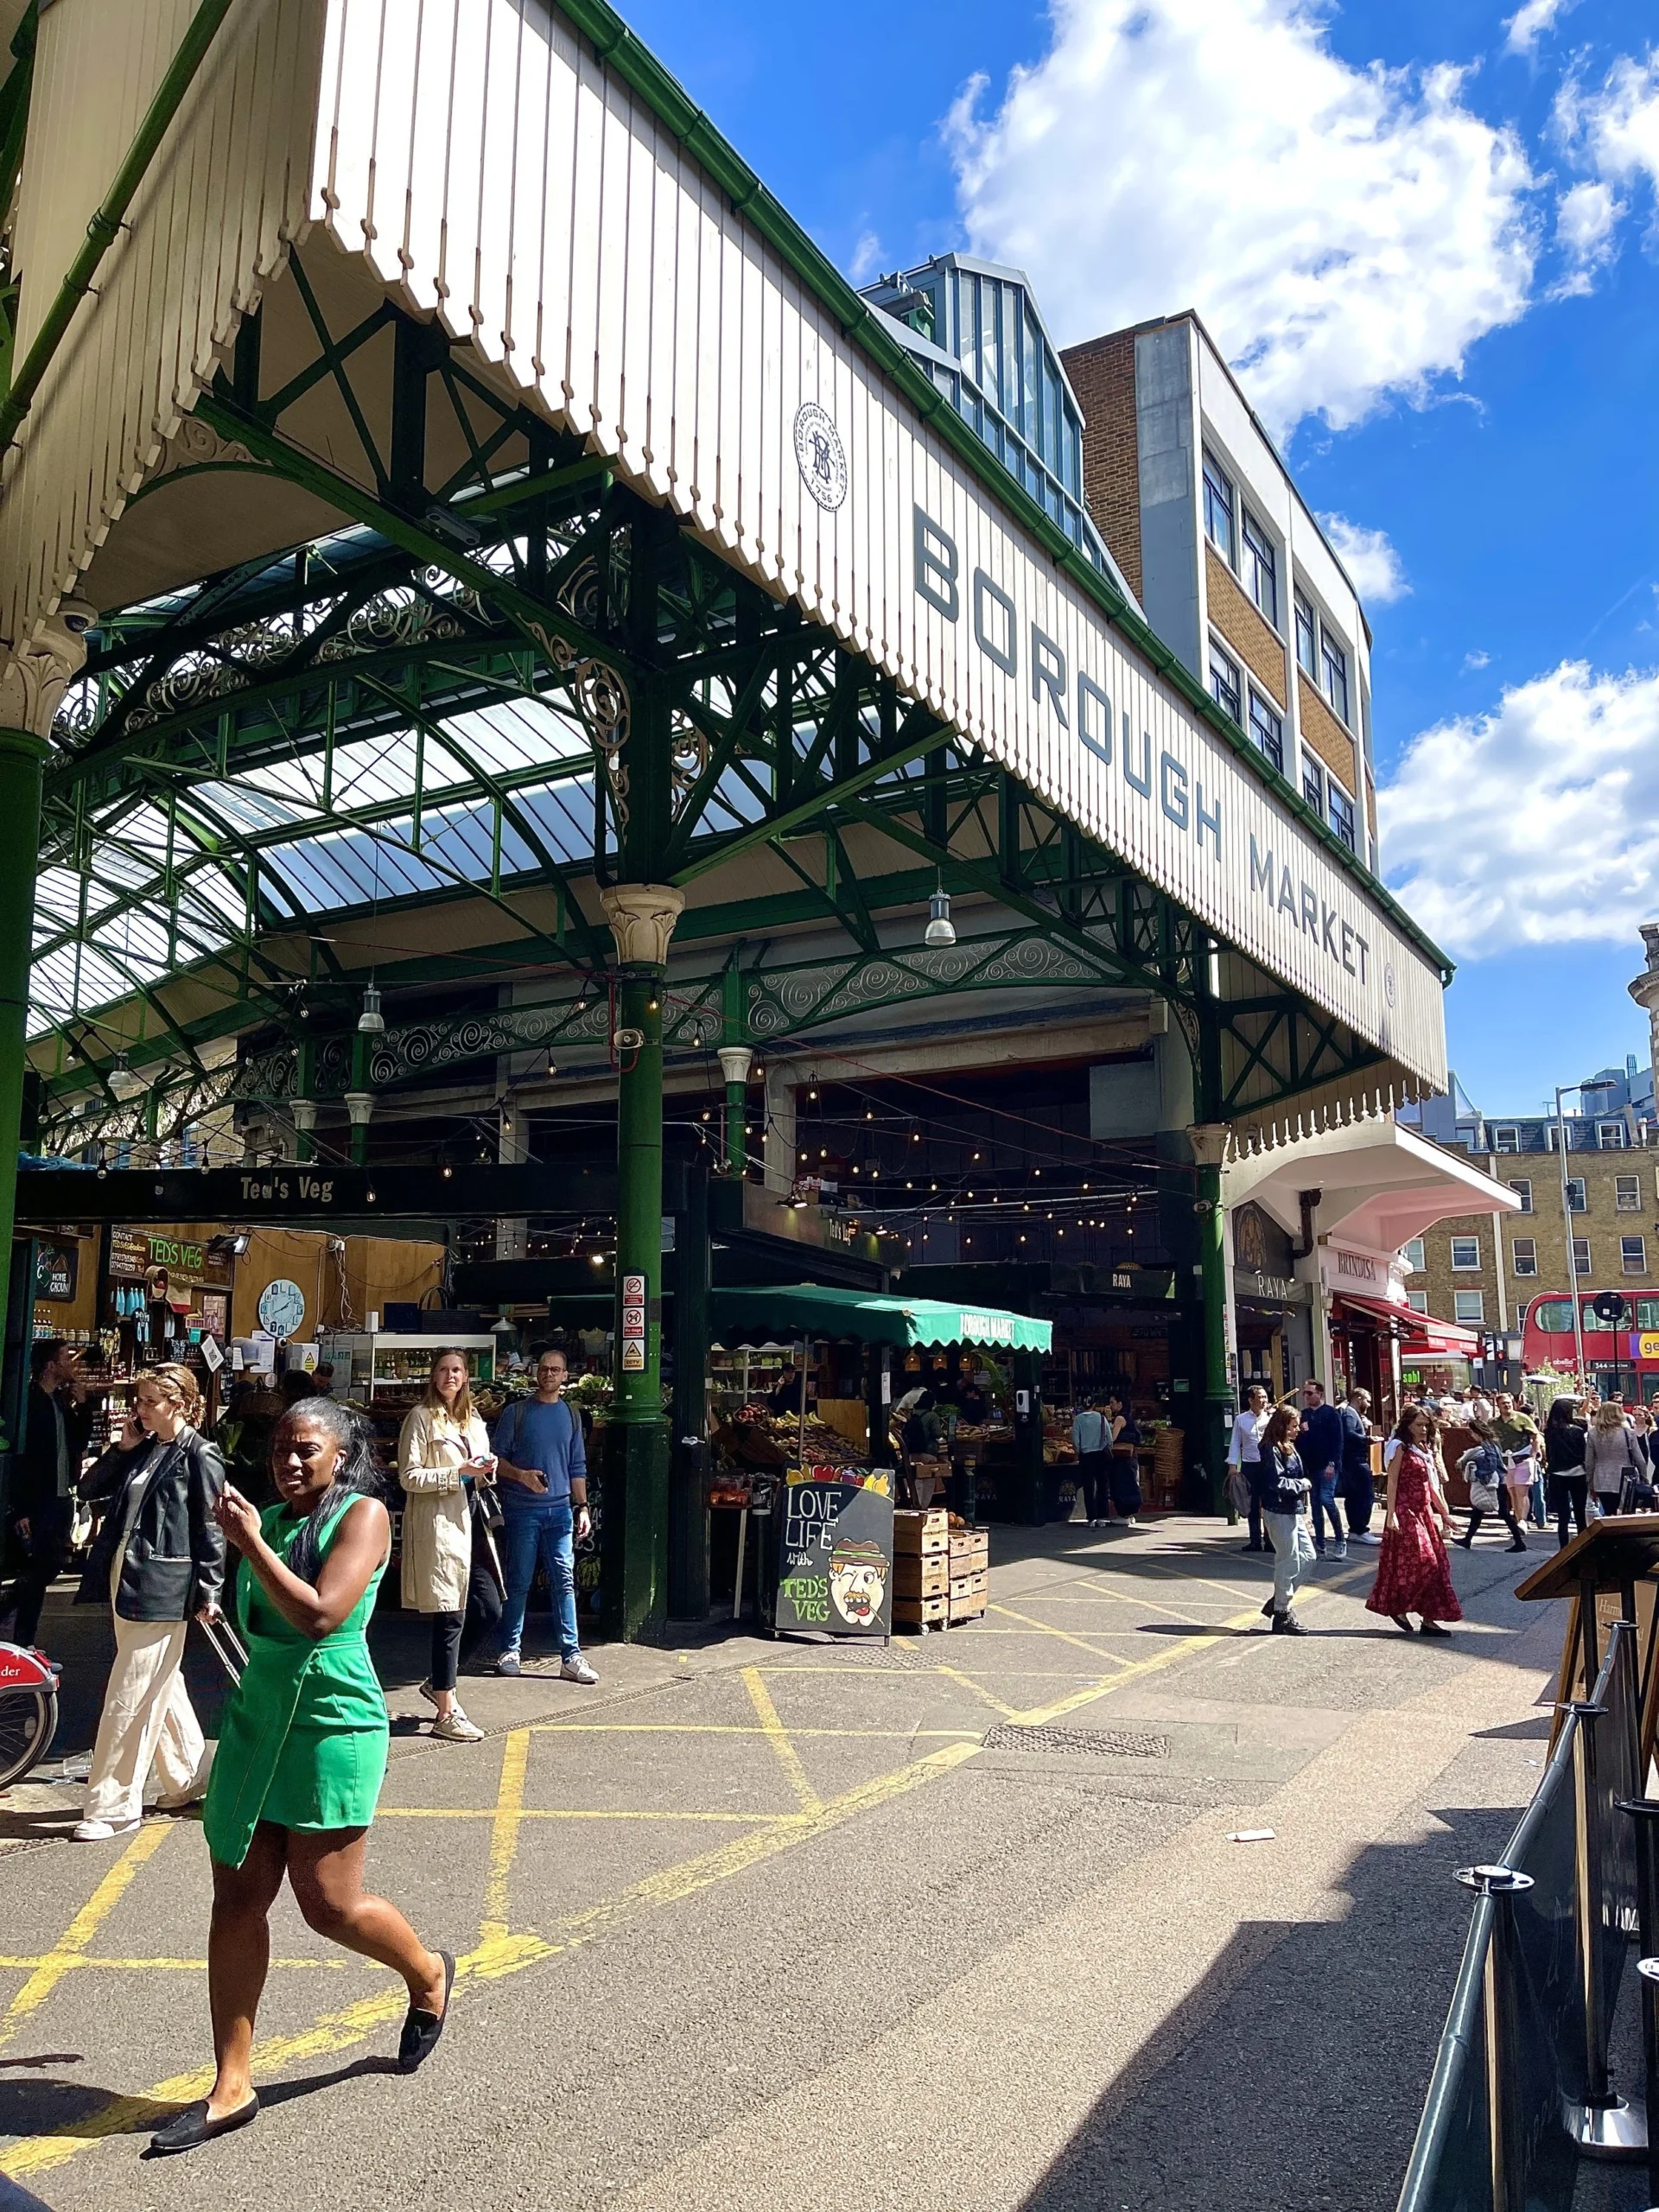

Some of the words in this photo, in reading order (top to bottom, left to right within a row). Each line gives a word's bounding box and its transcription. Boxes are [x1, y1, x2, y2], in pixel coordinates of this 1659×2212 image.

[797, 408, 826, 454] BOROUGH
[828, 425, 845, 493] MARKET
[810, 478, 833, 504] 1756
[913, 501, 1221, 862] BOROUGH
[1249, 832, 1370, 986] MARKET
[298, 1176, 334, 1203] Veg
[147, 1237, 179, 1265] TED'S
[181, 1243, 203, 1270] VEG
[1338, 1252, 1376, 1281] BRINDISA
[52, 1273, 67, 1282] HOME
[1112, 1274, 1132, 1288] RAYA
[1257, 1274, 1288, 1300] RAYA
[787, 1487, 842, 1523] LOVE
[785, 1518, 836, 1551] LIFE
[786, 1551, 814, 1567] with
[780, 1575, 829, 1599] TED'S
[792, 1599, 831, 1622] VEG
[0, 1665, 21, 1676] der
